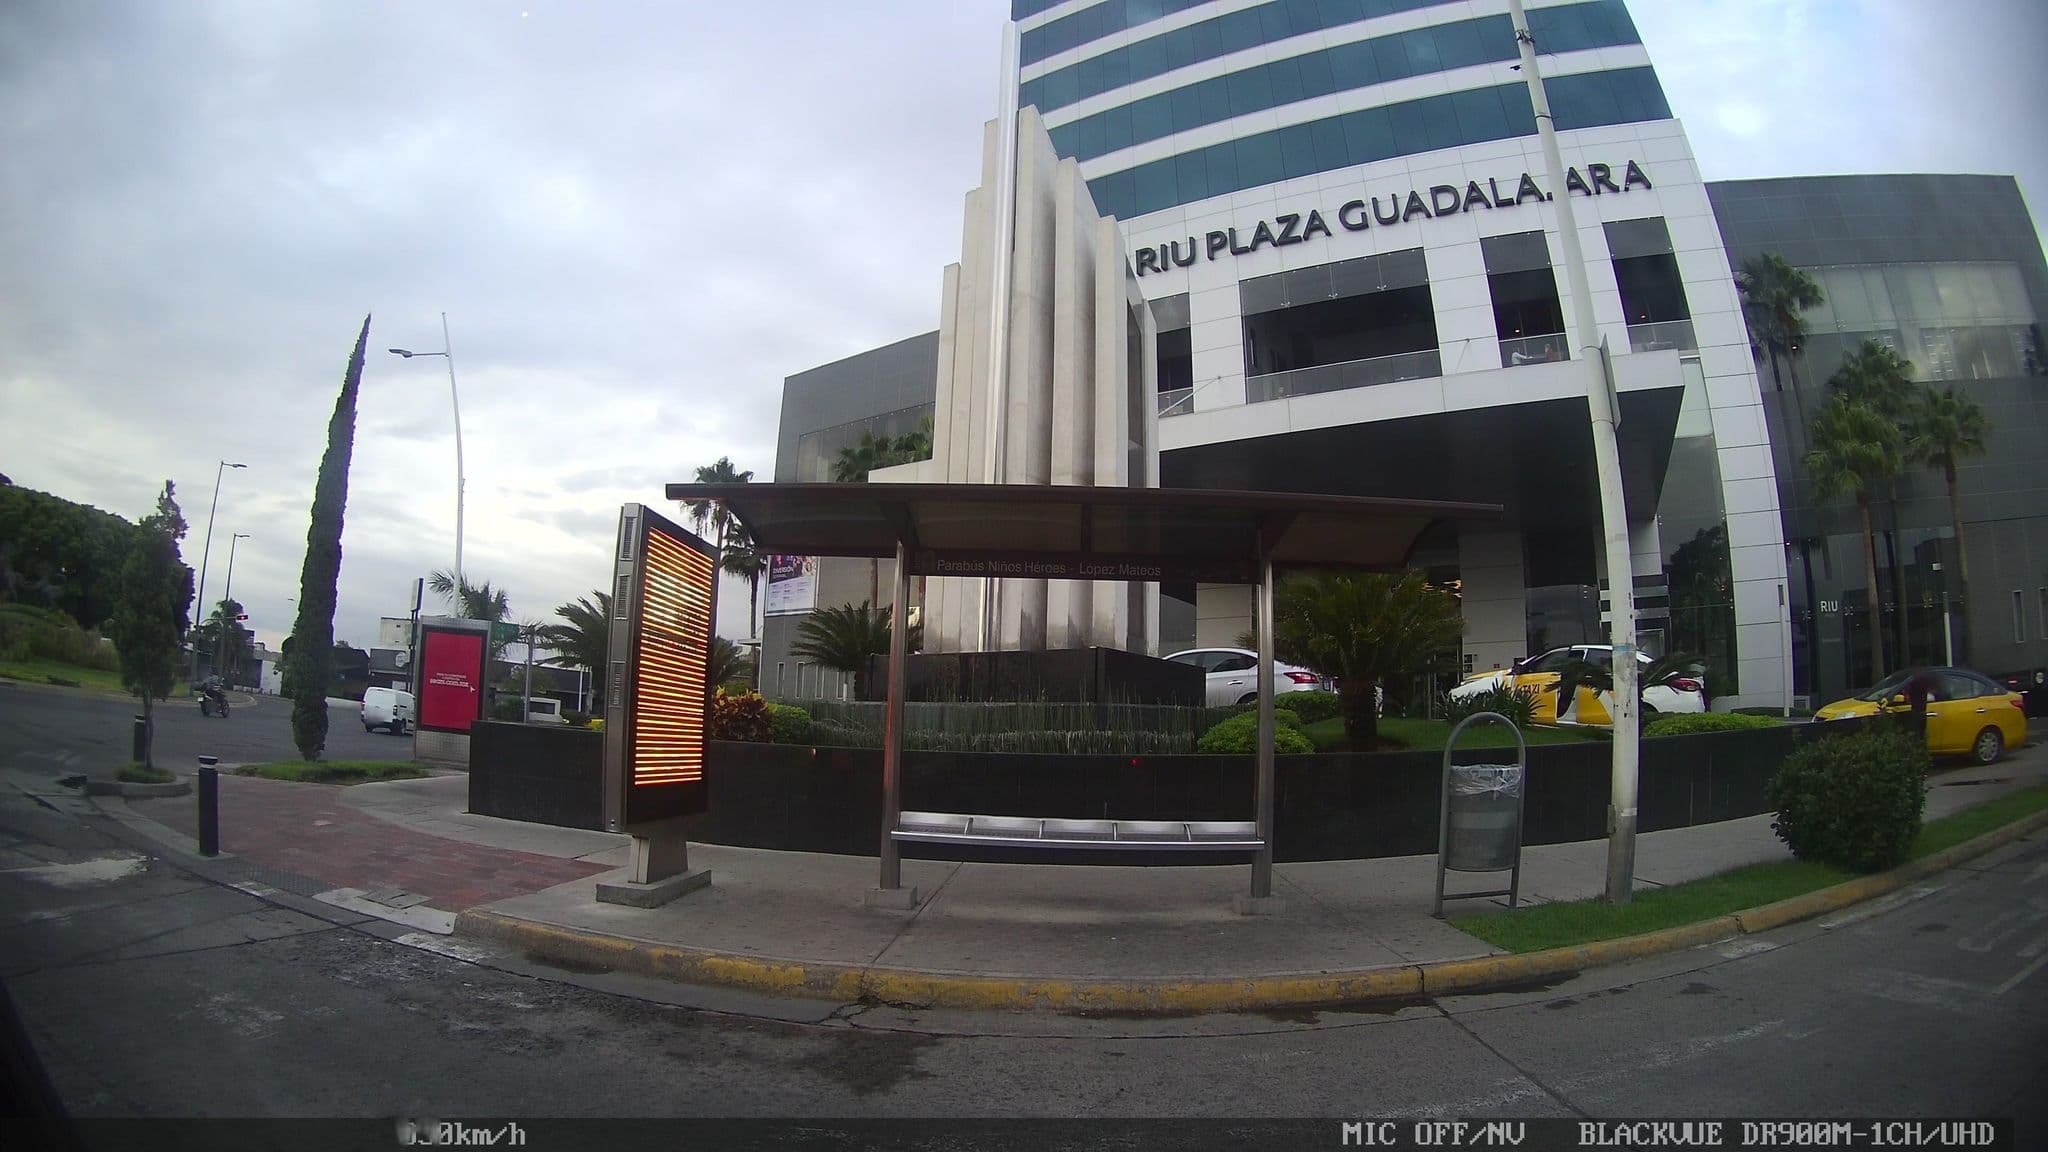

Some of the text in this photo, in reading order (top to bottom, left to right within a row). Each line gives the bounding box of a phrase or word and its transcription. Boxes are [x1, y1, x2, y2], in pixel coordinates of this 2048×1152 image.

[1135, 159, 1653, 277] RIU PLAZA GUADALAARA
[1119, 564, 1161, 577] Mateos
[1820, 600, 1839, 612] RIU
[1522, 683, 1541, 695] TAXI
